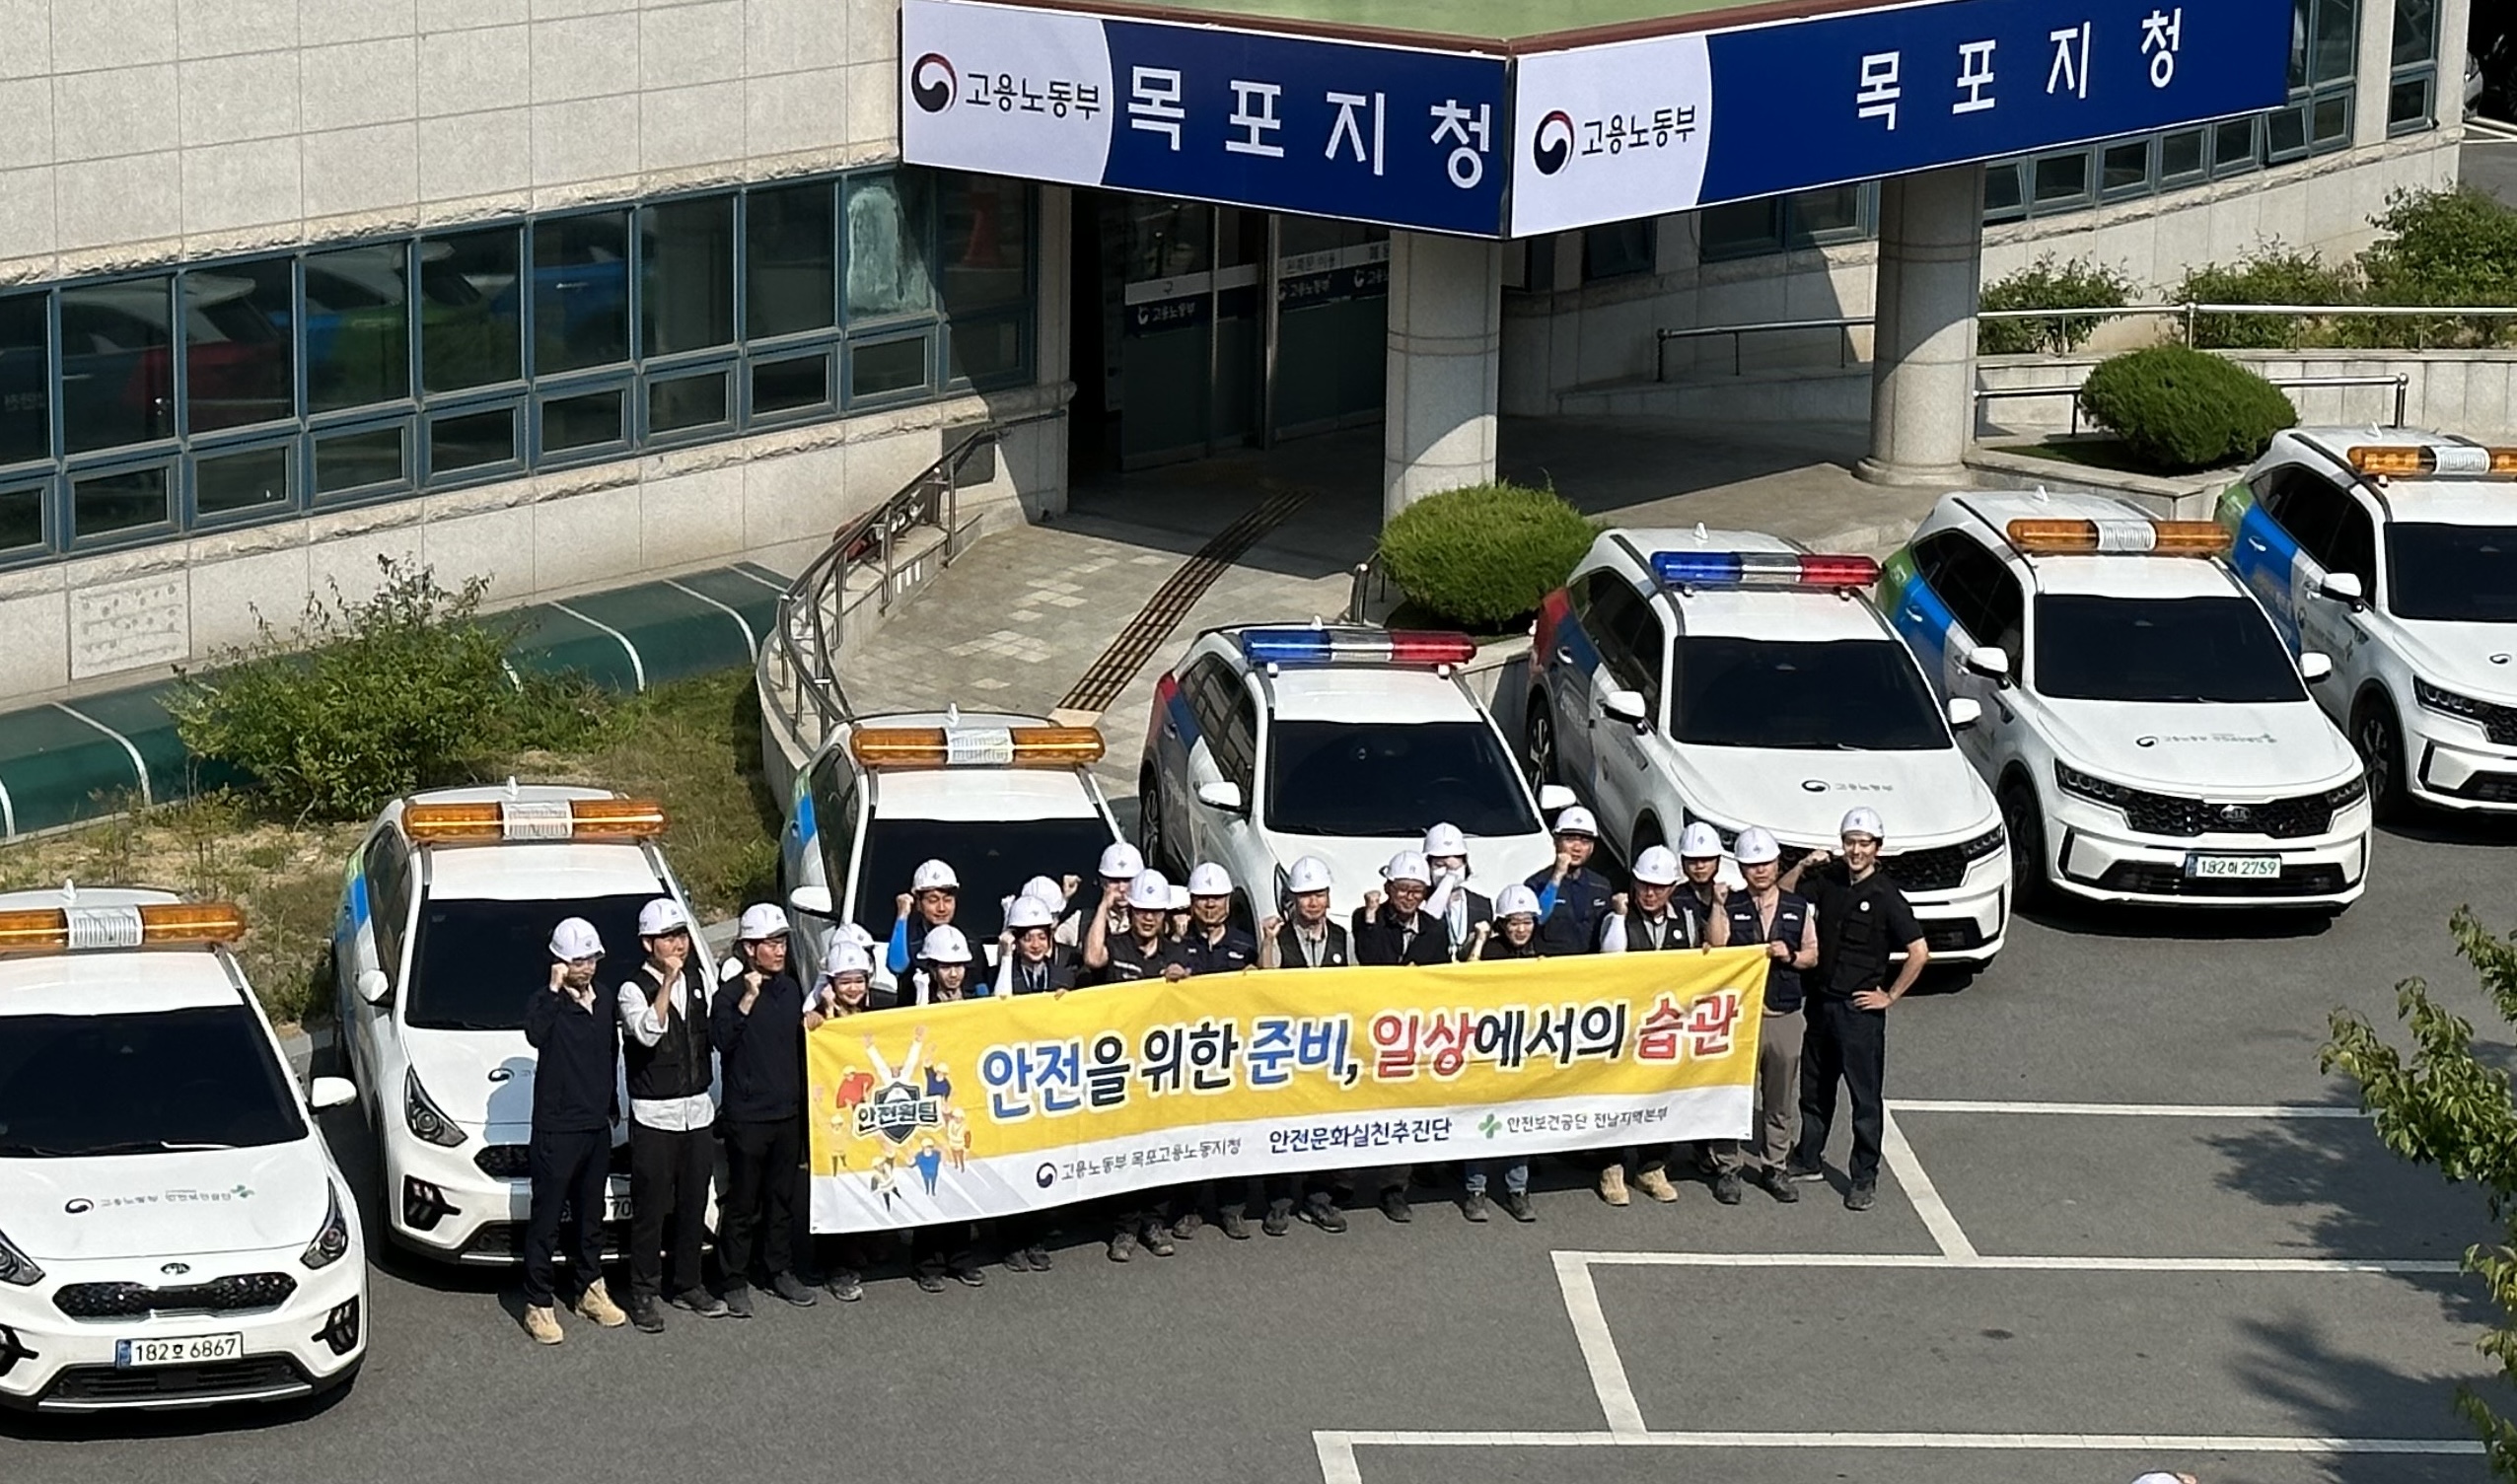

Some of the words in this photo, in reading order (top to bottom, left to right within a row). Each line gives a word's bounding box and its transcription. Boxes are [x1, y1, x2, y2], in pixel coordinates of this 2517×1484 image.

[966, 72, 1101, 121] 고용노동부
[1582, 105, 1696, 159] 고용노동부
[982, 1036, 1130, 1118] 안전을
[1140, 1022, 1239, 1097] 위한
[1248, 1017, 1358, 1086] 준비,
[1372, 1003, 1625, 1077] 일상에서의
[1637, 992, 1740, 1060] 습관
[858, 1100, 938, 1132] 안전원팀
[1507, 1112, 1588, 1134] 안전보건공단
[1061, 1153, 1127, 1181] 고용노동부
[1131, 1137, 1242, 1168] 목포고용노동지청
[135, 1342, 184, 1363] 182호
[189, 1337, 237, 1360] 6867
